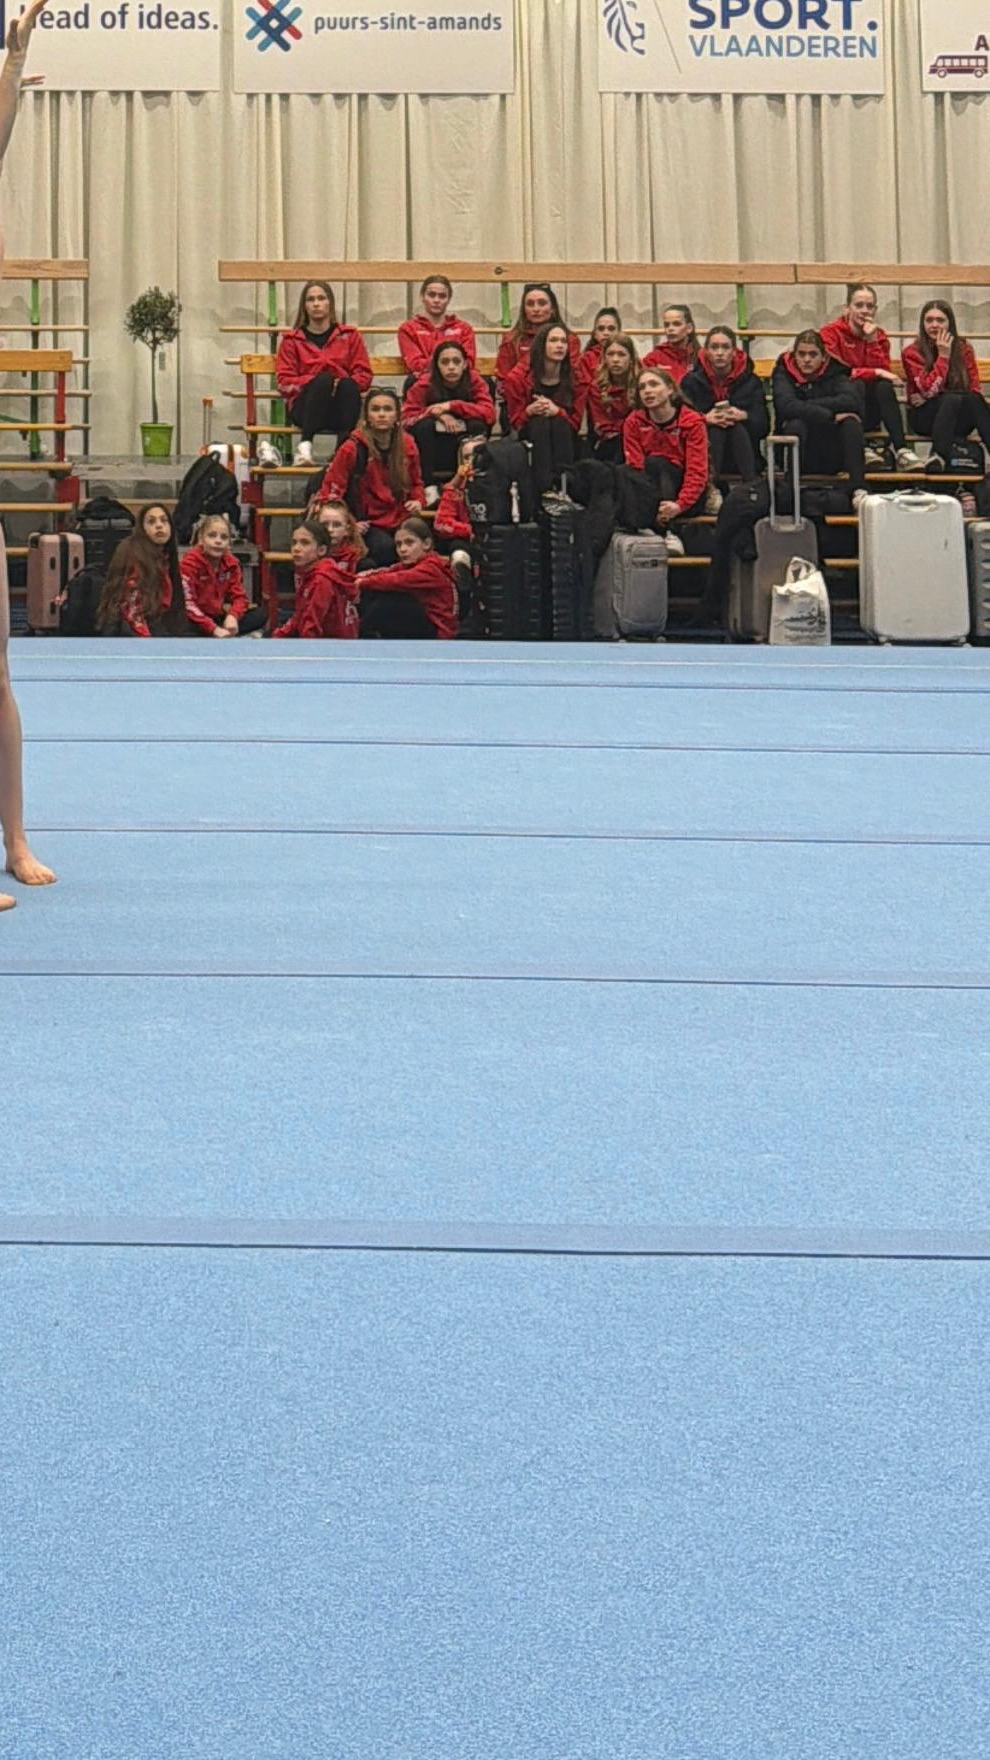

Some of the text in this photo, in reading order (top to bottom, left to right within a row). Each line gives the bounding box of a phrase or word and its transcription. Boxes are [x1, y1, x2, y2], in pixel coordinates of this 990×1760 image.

[100, 2, 129, 30] of
[137, 3, 219, 30] ideas.
[313, 12, 502, 35] puurs-sint-amands
[689, 34, 877, 59] VLAANDEREN
